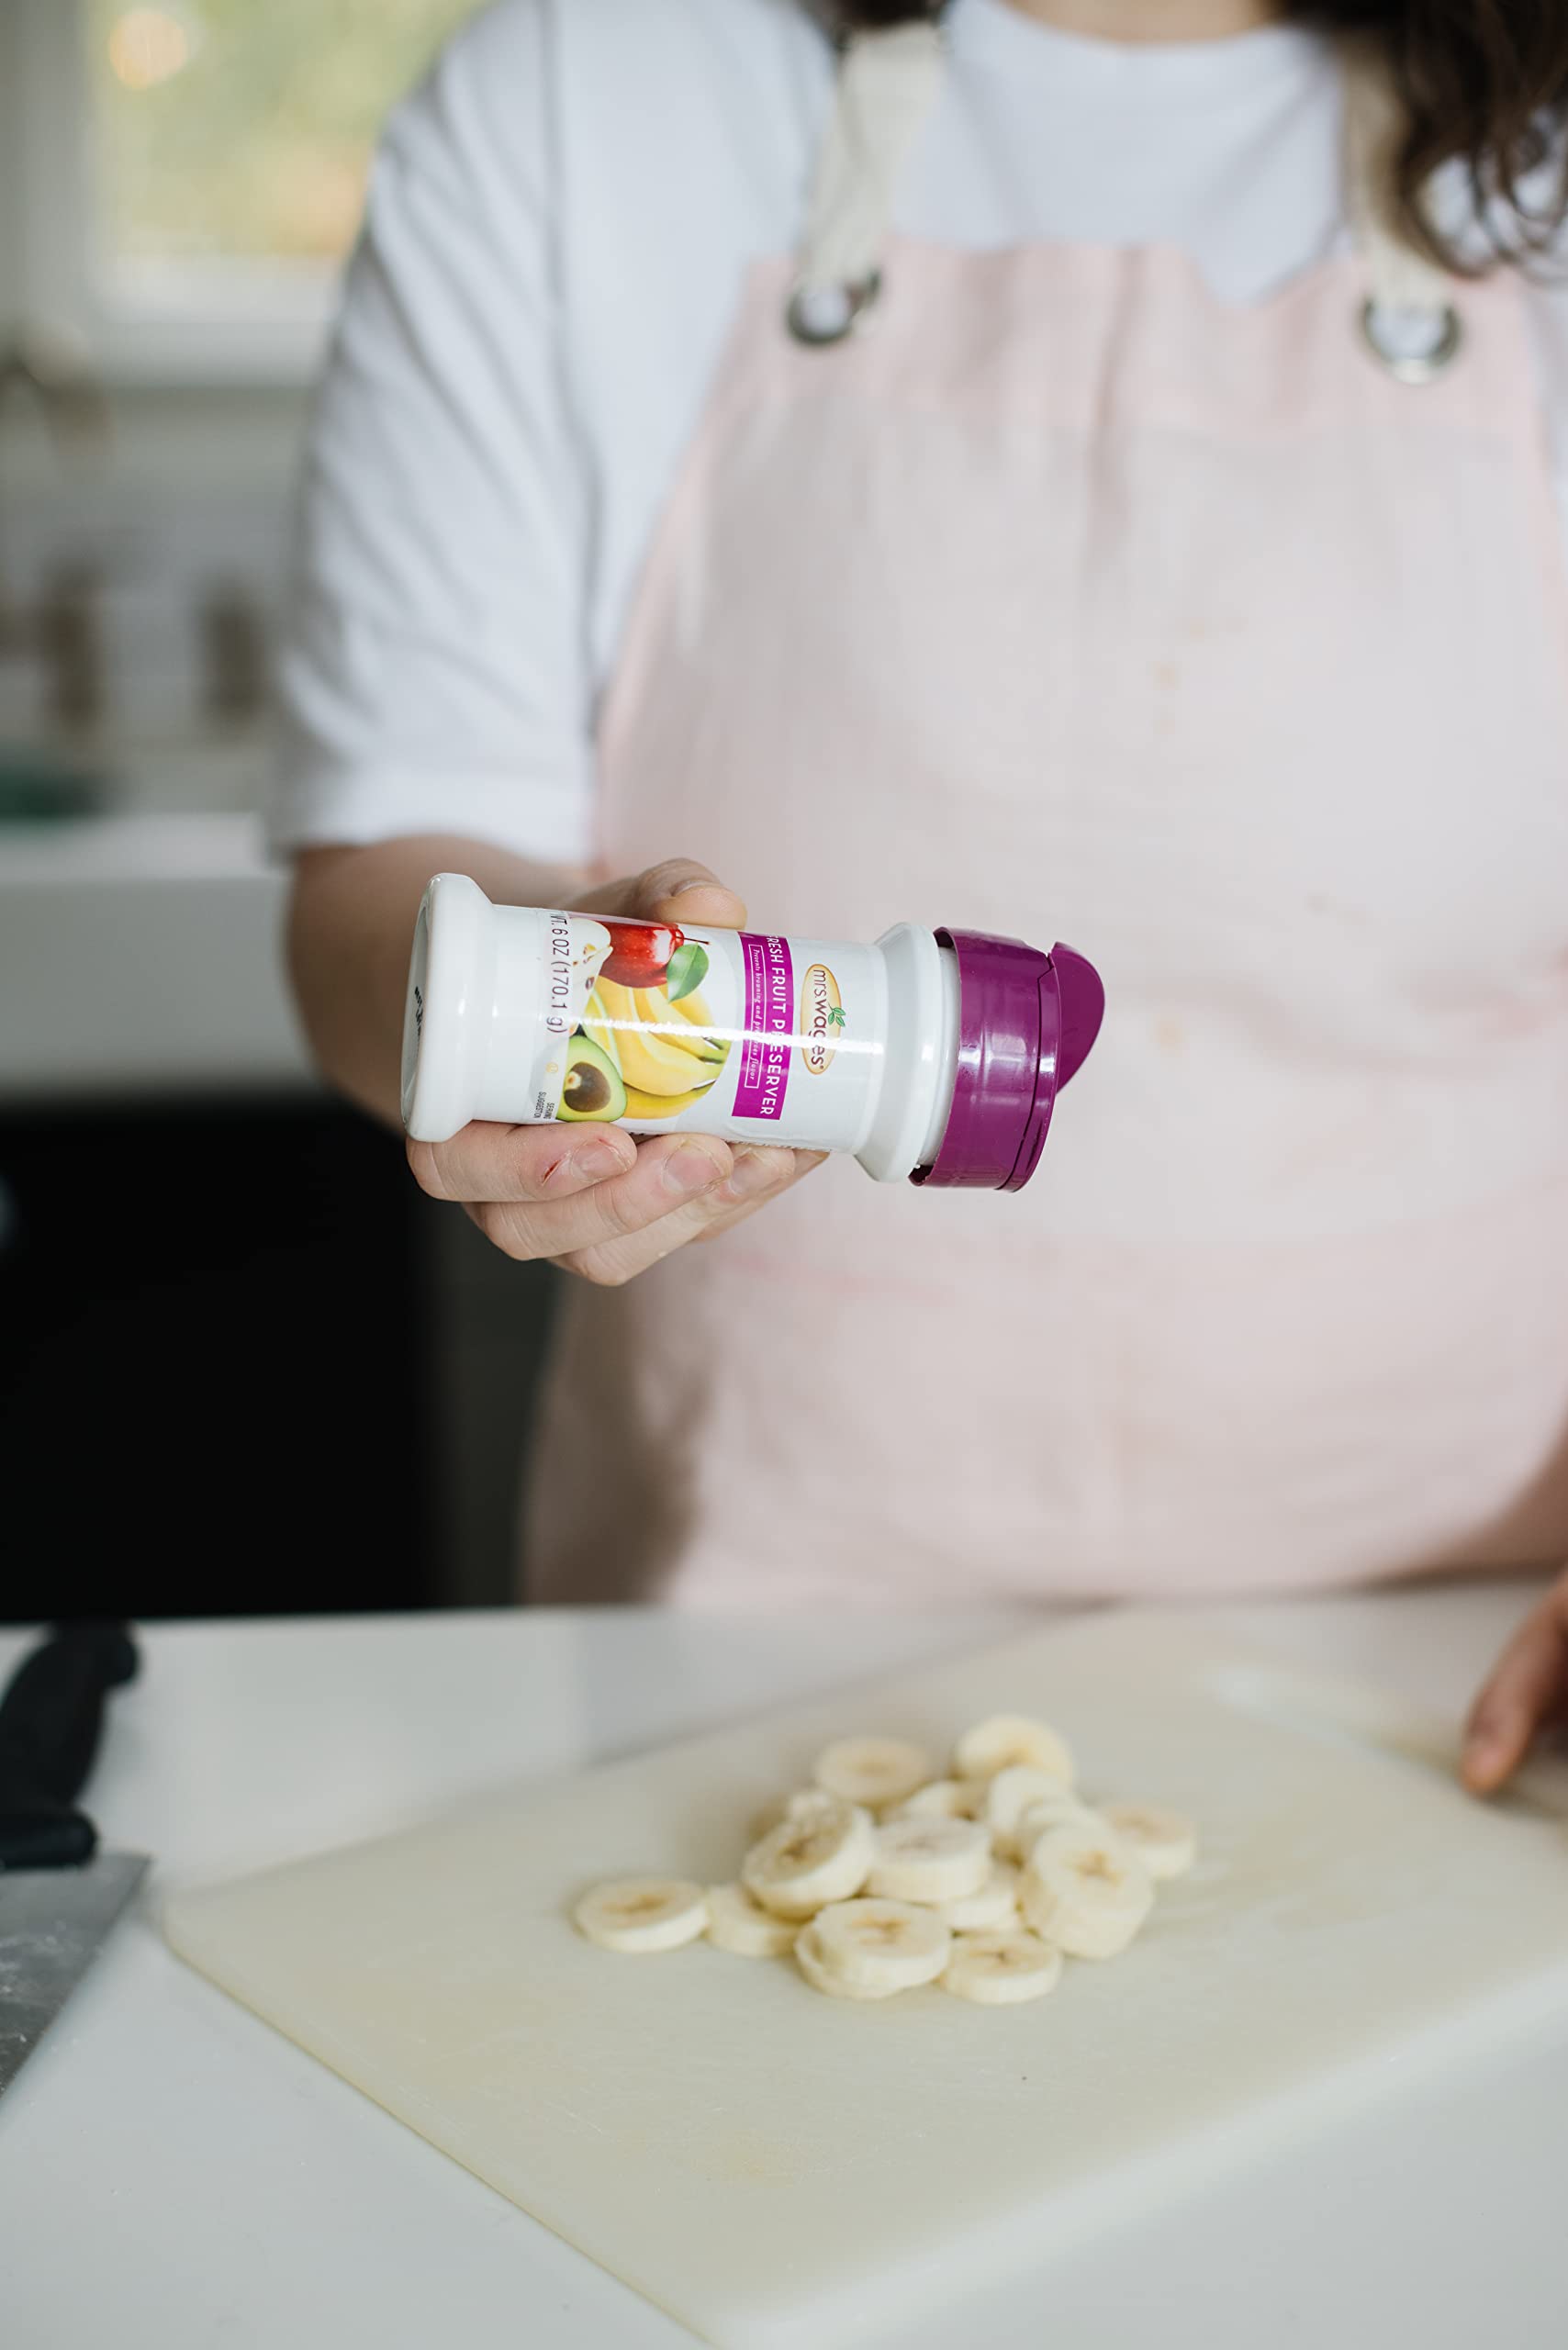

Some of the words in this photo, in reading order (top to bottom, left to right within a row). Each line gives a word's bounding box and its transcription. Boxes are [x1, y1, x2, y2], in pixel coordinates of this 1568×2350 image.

[553, 939, 569, 957] OZ
[753, 949, 761, 970] Prevents
[767, 934, 784, 963] FRESH
[551, 961, 571, 1009] (170.1
[754, 972, 763, 1002] browning
[772, 967, 787, 1013] FRUIT
[749, 1057, 759, 1080] flavor
